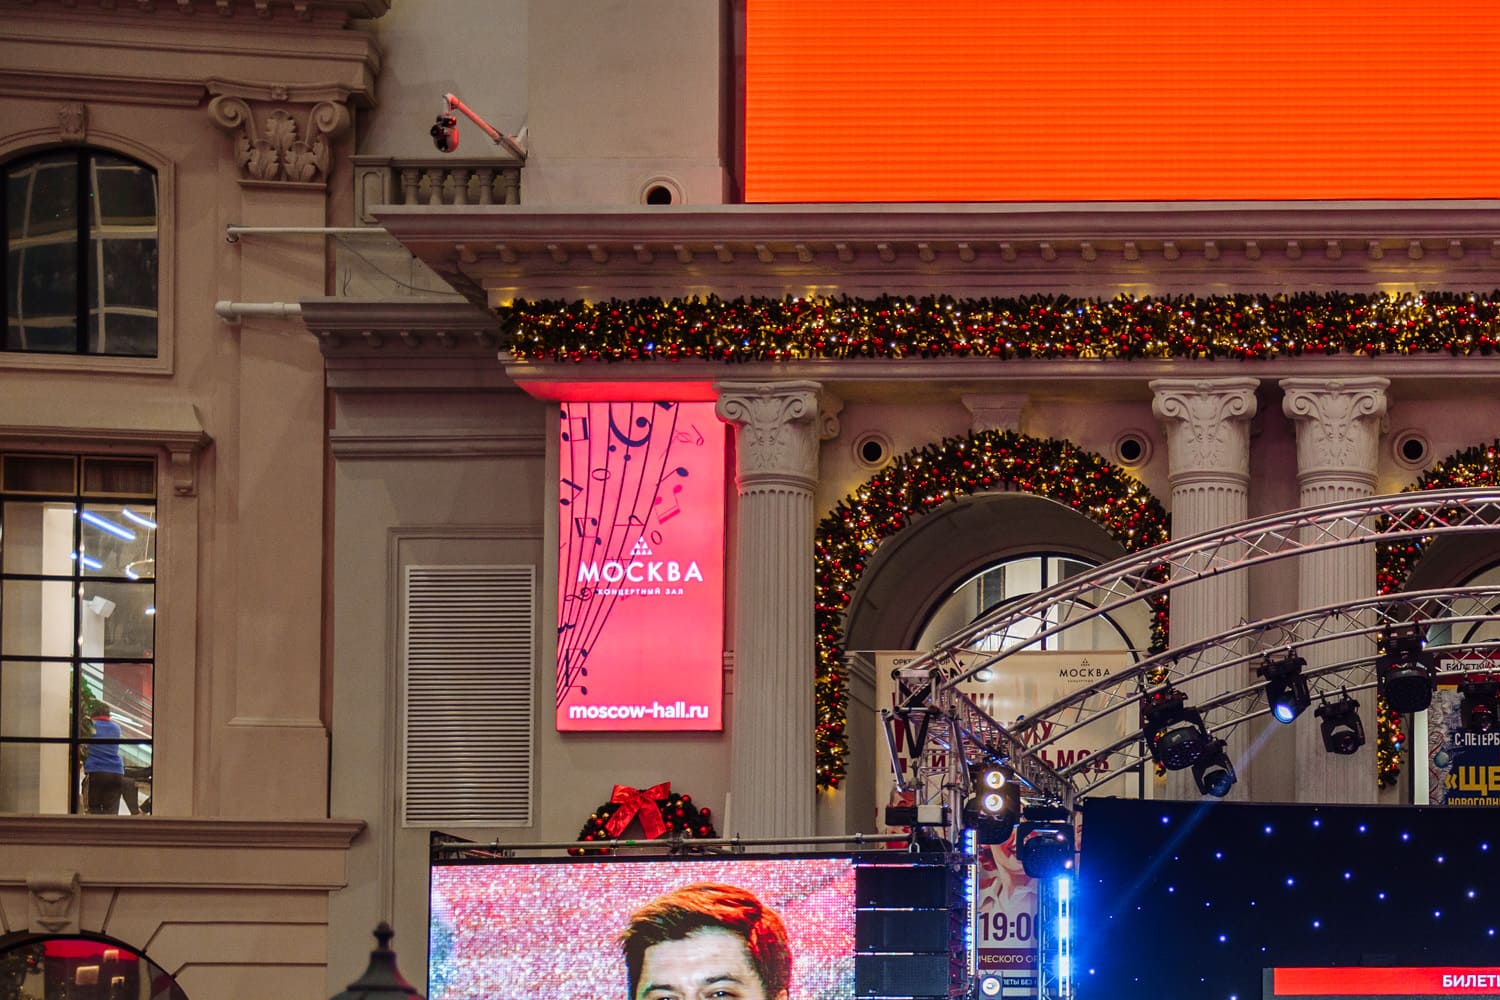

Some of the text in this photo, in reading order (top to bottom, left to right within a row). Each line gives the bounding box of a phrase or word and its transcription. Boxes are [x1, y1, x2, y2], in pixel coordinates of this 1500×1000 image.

[577, 561, 704, 582] МОСКВА
[598, 587, 660, 597] КОНЦЕРТНЫЙ
[1059, 668, 1111, 678] МОСКВА
[569, 701, 709, 719] moscow-hall.ru
[979, 954, 1023, 963] ЧЕСКОГО
